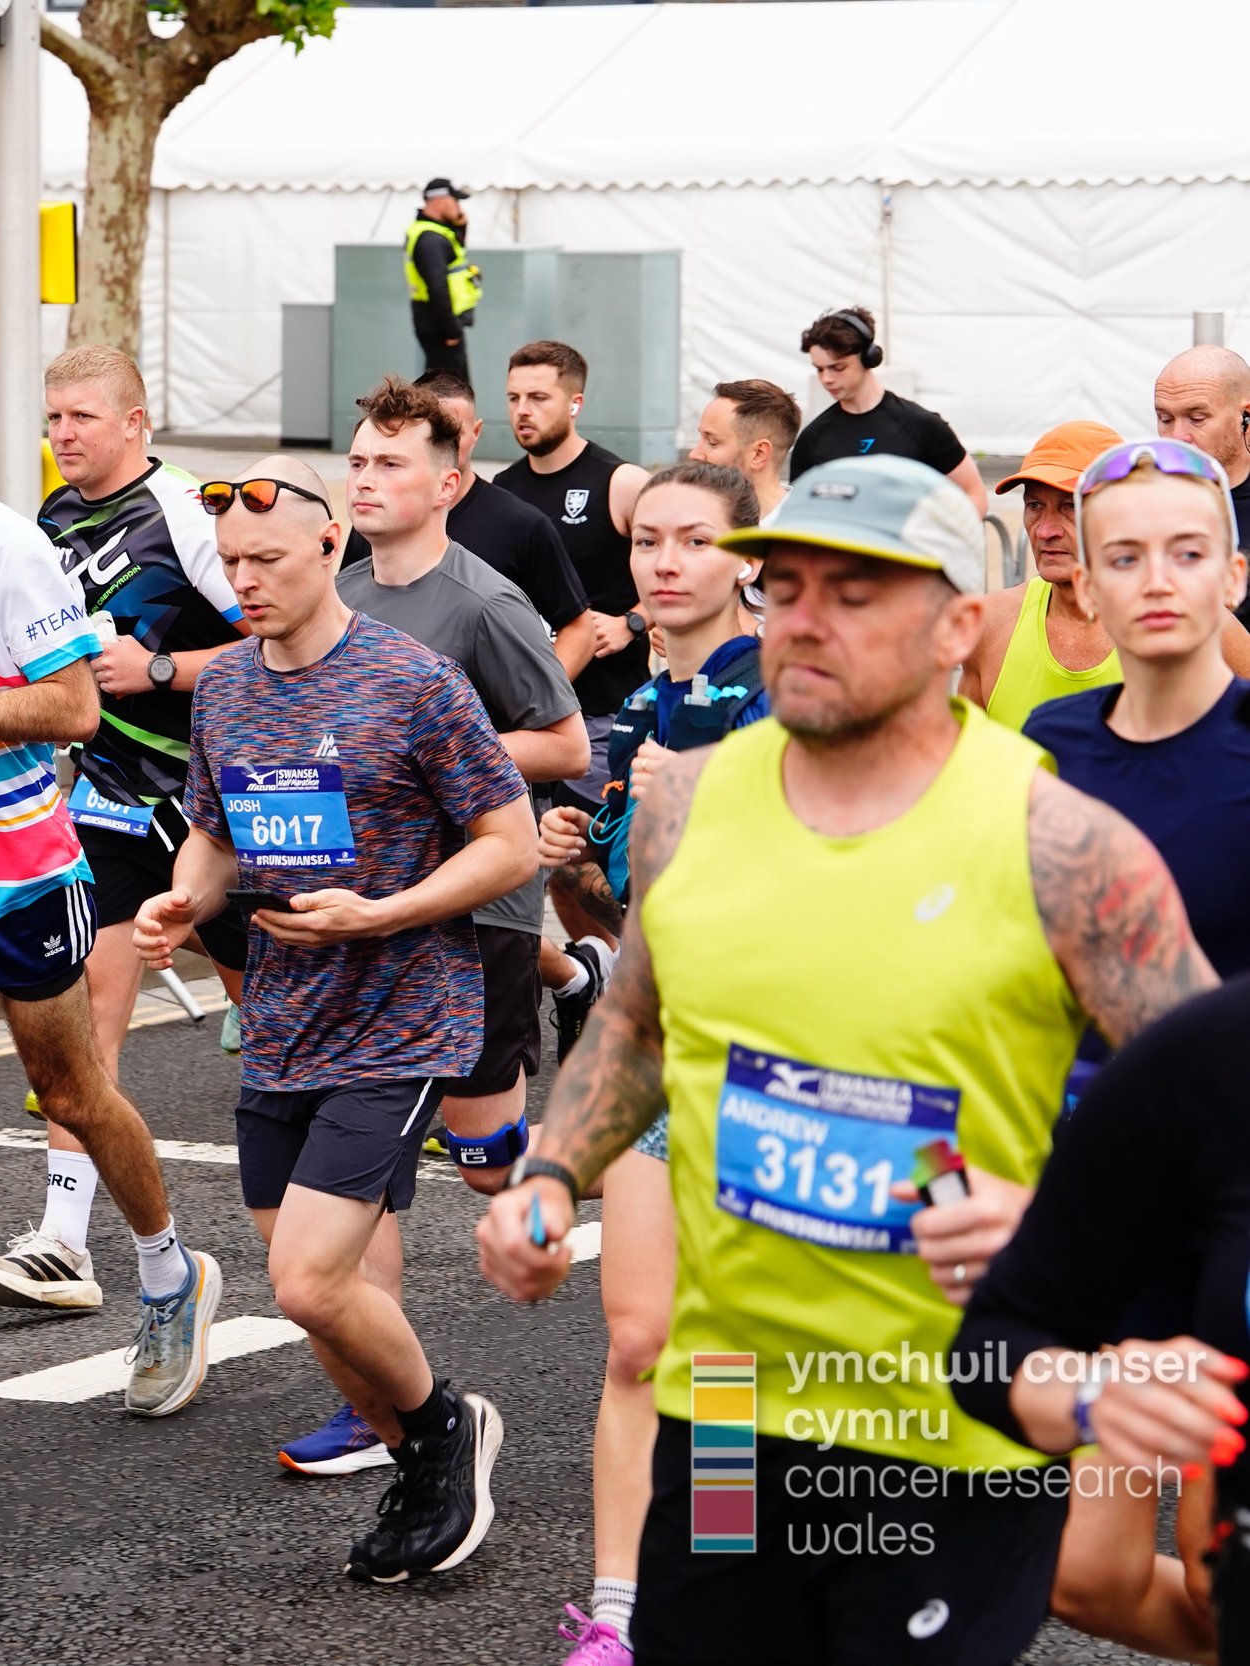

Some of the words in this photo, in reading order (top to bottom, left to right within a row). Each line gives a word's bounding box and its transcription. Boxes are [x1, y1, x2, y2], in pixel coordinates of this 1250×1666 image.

[278, 769, 319, 778] SWANSEA
[227, 800, 261, 812] JOSH
[252, 815, 323, 846] 6017
[256, 854, 332, 866] #RUNSWANSEA
[44, 946, 65, 957] adidas
[722, 1094, 830, 1145] ANDREW
[461, 1152, 487, 1164] G
[754, 1134, 893, 1217] 3131
